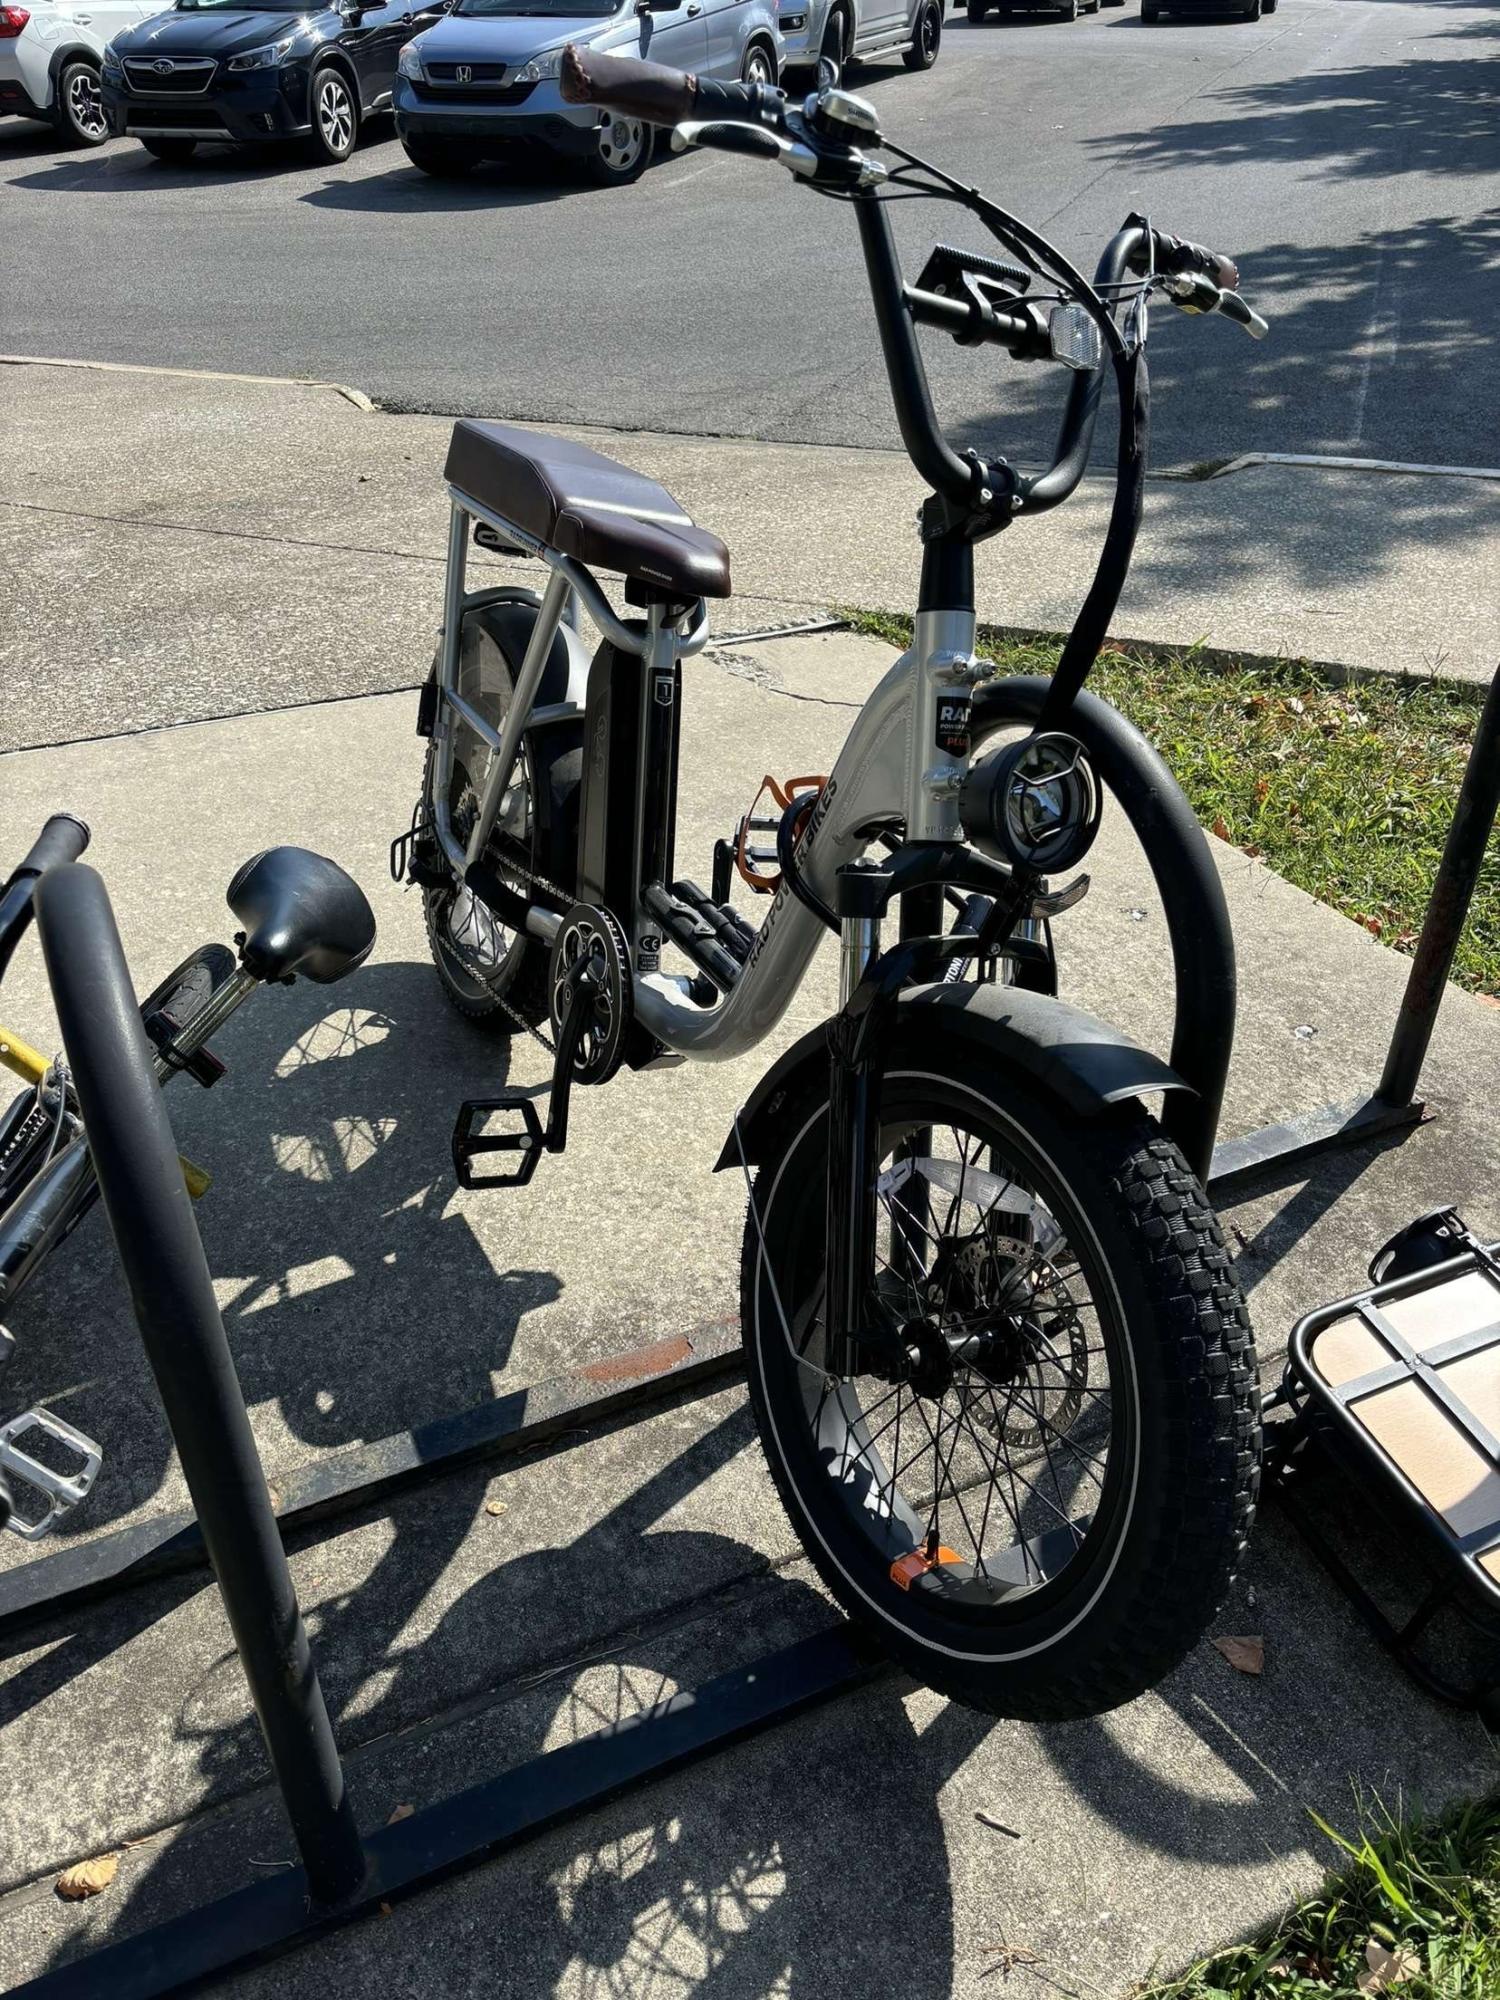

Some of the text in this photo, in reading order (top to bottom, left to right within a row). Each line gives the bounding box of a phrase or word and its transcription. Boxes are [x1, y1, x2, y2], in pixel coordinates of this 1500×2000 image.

[750, 928, 769, 968] RAD
[805, 778, 837, 845] BIKES
[643, 937, 659, 950] CE
